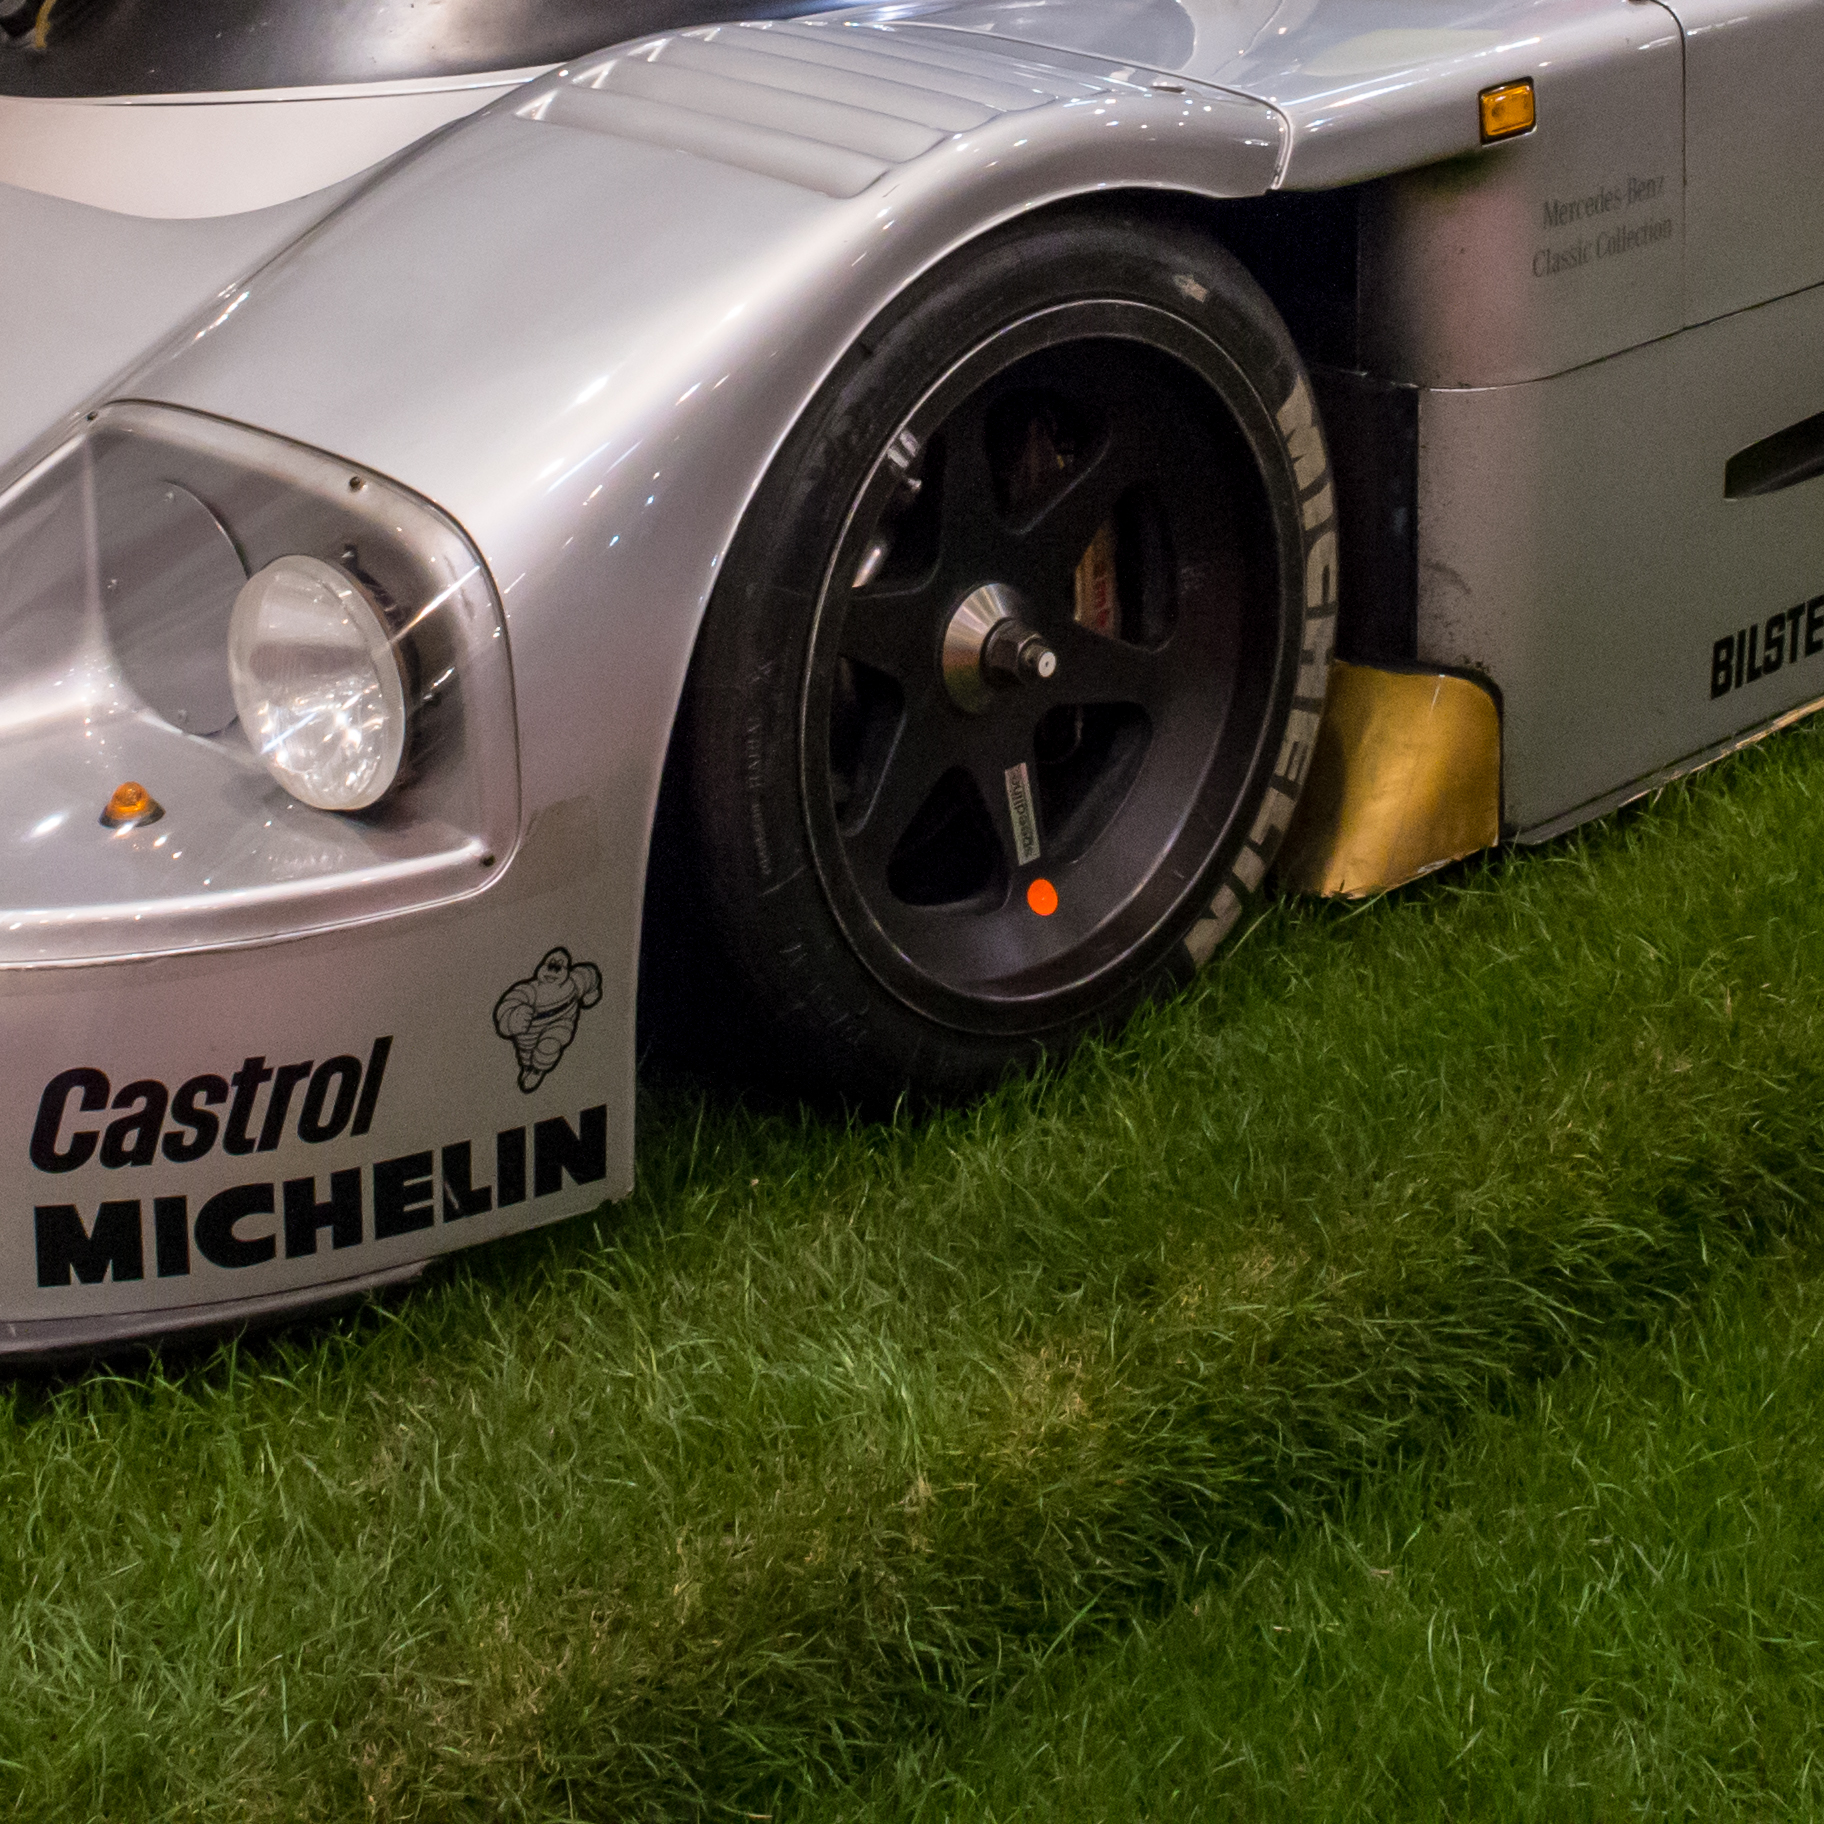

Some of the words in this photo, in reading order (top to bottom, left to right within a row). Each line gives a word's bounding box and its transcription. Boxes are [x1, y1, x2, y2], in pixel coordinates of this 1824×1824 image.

[1532, 238, 1594, 278] Classic
[1596, 218, 1673, 259] Collection
[1542, 176, 1665, 229] Mercedes-Benz
[1183, 375, 1339, 975] MICHELIN
[27, 1035, 393, 1175] Castrol
[33, 1105, 609, 1288] MICHELIN
